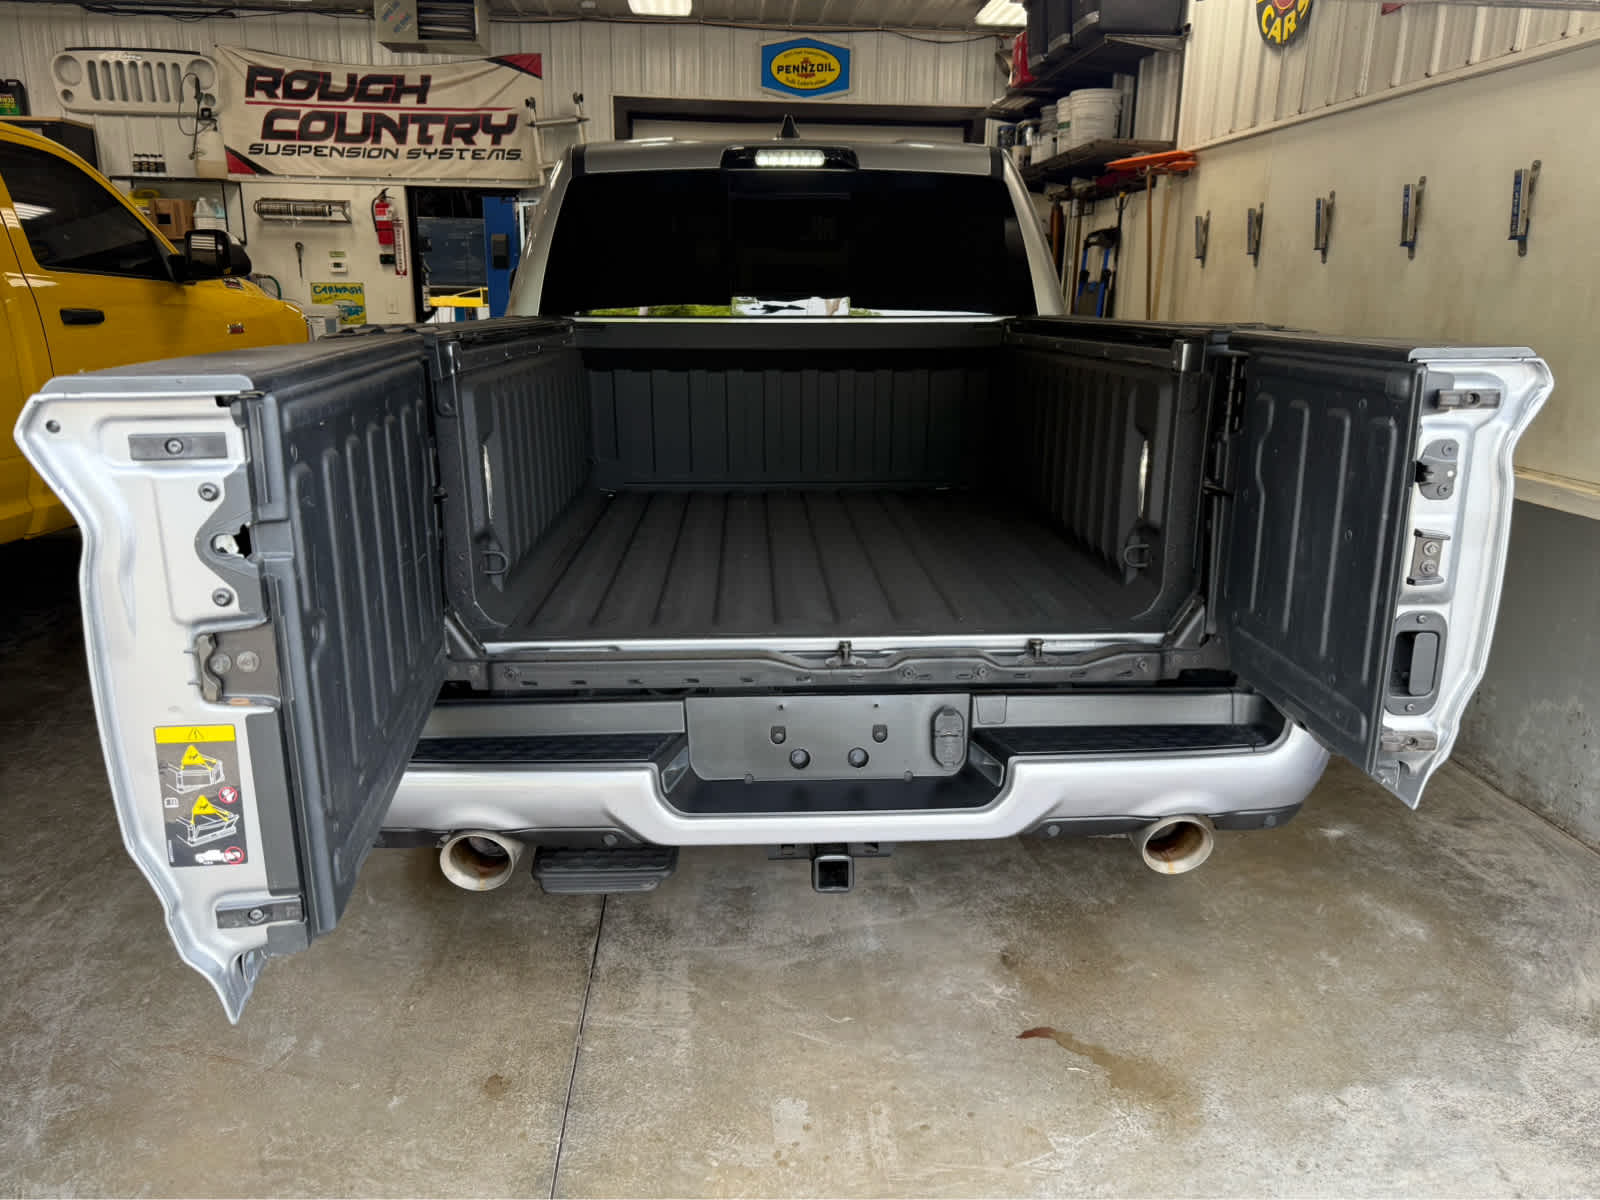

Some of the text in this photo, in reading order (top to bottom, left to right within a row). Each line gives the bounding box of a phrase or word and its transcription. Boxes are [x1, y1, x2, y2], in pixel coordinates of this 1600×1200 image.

[776, 63, 835, 75] PENNZOIL
[245, 65, 432, 104] ROUGH
[260, 108, 519, 146] COUNTRY
[247, 143, 522, 161] SUSPENSION SYSTEMS
